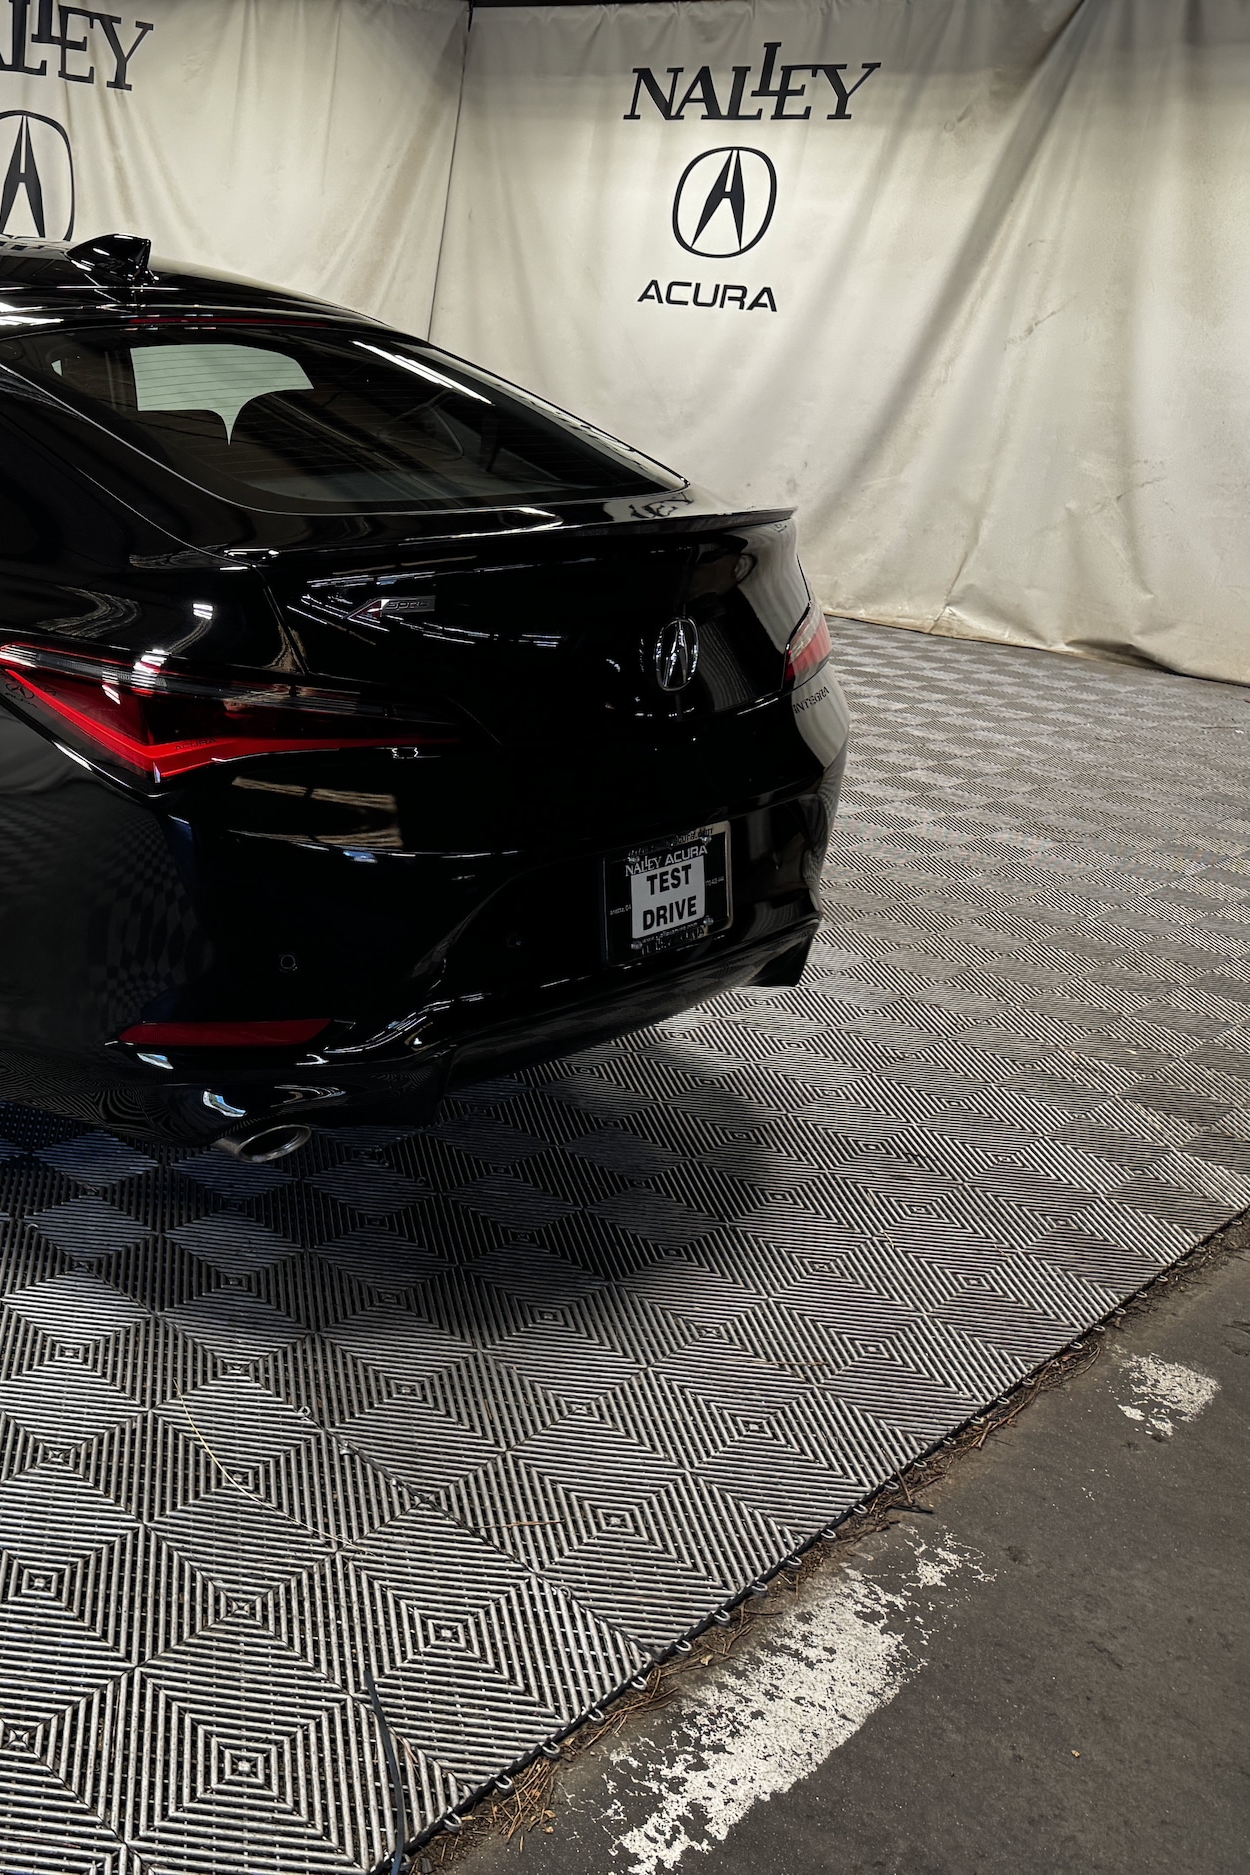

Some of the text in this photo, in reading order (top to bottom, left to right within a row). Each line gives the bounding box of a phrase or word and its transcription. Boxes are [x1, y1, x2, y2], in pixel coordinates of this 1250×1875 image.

[623, 41, 882, 121] NALLEY
[636, 278, 778, 313] ACURA
[792, 686, 830, 714] INTEGRA
[624, 844, 708, 877] NALLEY ACURA
[646, 863, 692, 895] TEST
[642, 895, 697, 931] DRIVE
